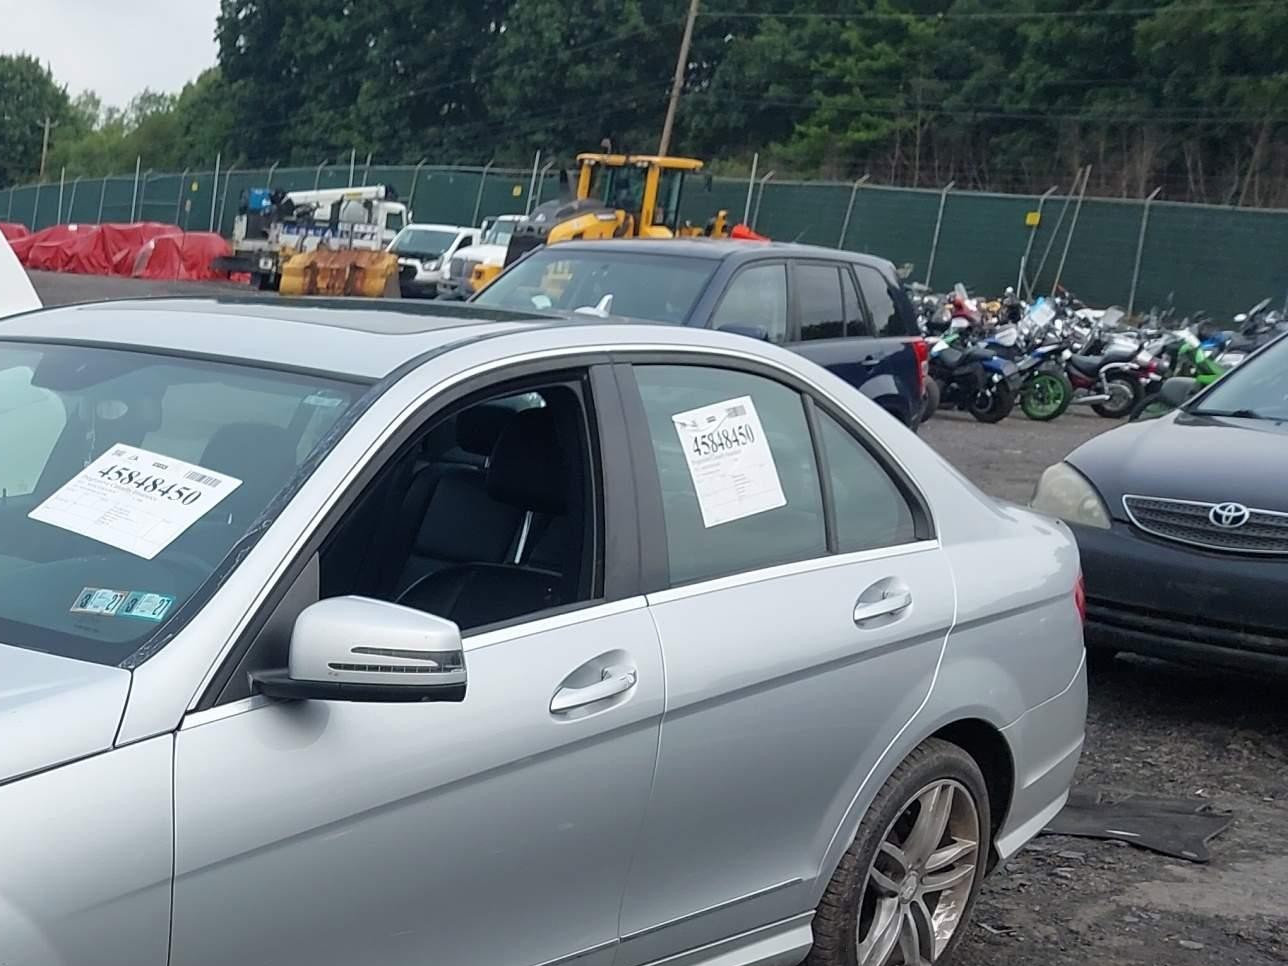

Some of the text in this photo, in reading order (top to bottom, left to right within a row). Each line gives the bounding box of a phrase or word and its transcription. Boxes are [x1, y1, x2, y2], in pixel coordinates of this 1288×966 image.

[694, 424, 755, 456] 45848450
[98, 464, 203, 506] 45848450
[105, 594, 123, 613] 27
[152, 598, 171, 617] 27
